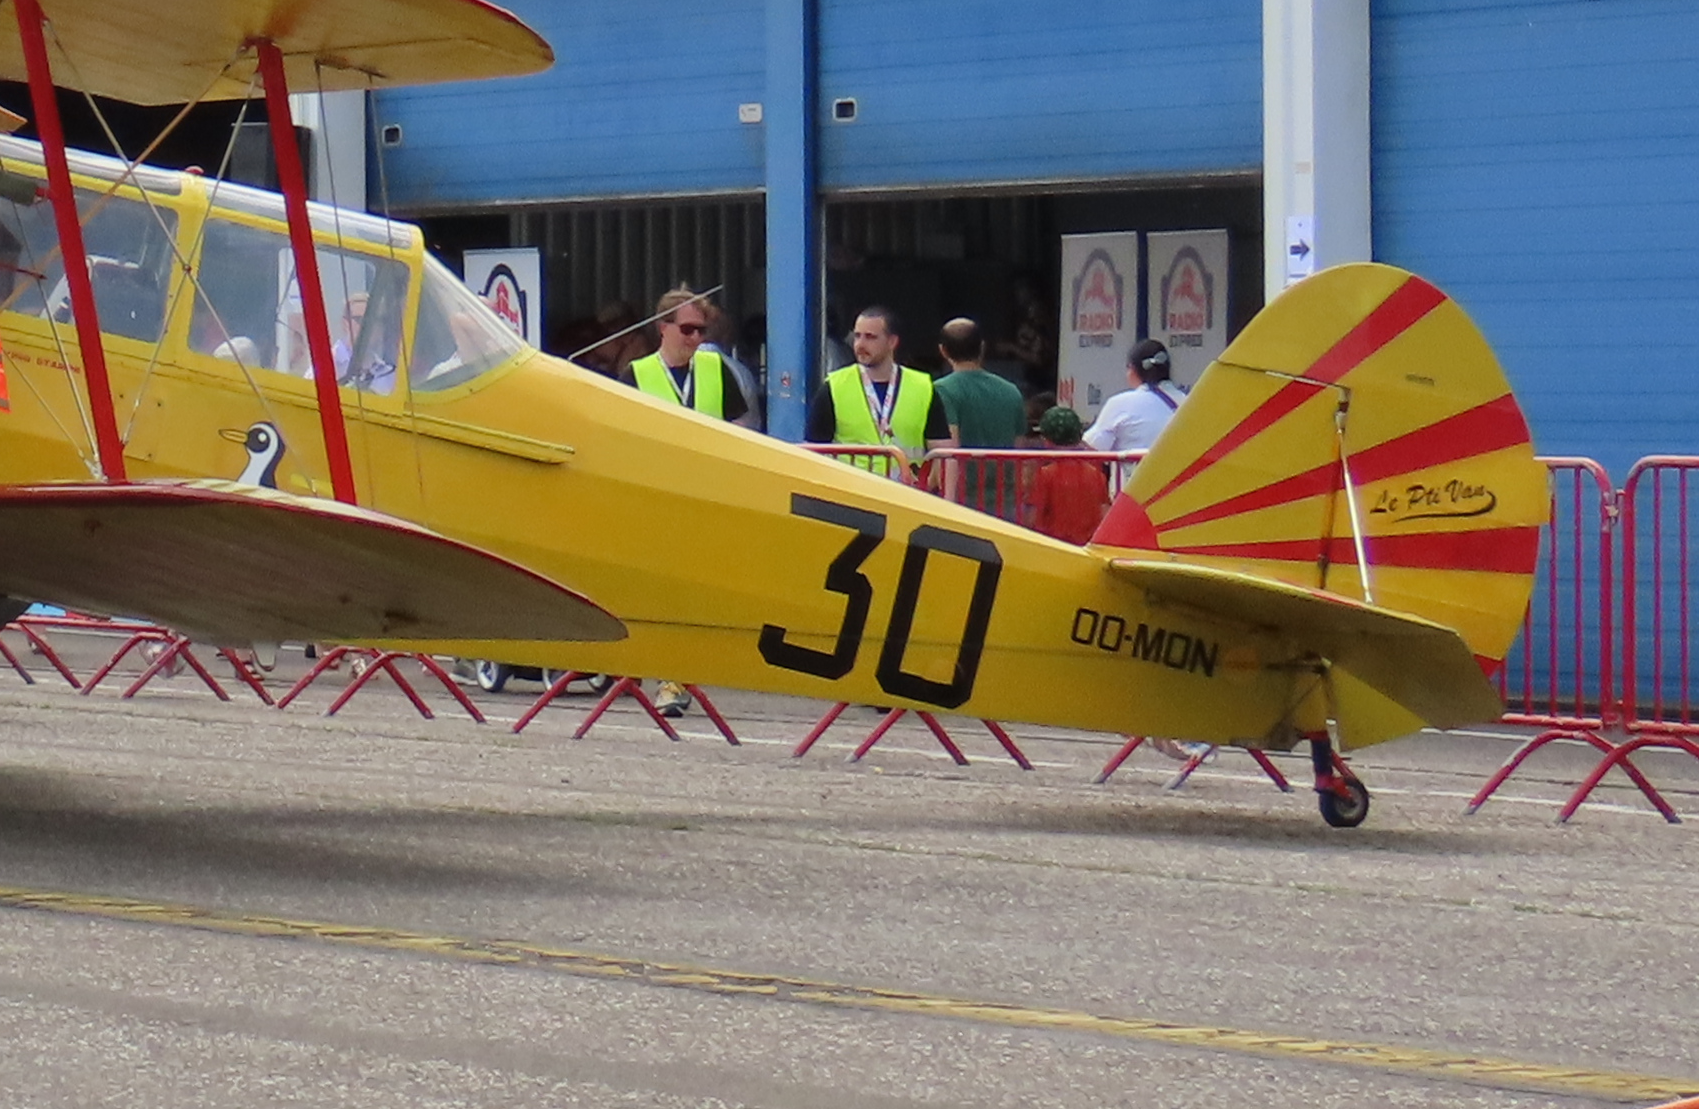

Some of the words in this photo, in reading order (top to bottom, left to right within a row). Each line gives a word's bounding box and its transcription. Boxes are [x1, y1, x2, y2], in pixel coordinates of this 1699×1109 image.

[1370, 489, 1398, 514] Le
[758, 492, 1003, 710] 30
[1071, 607, 1219, 678] OO-MON
